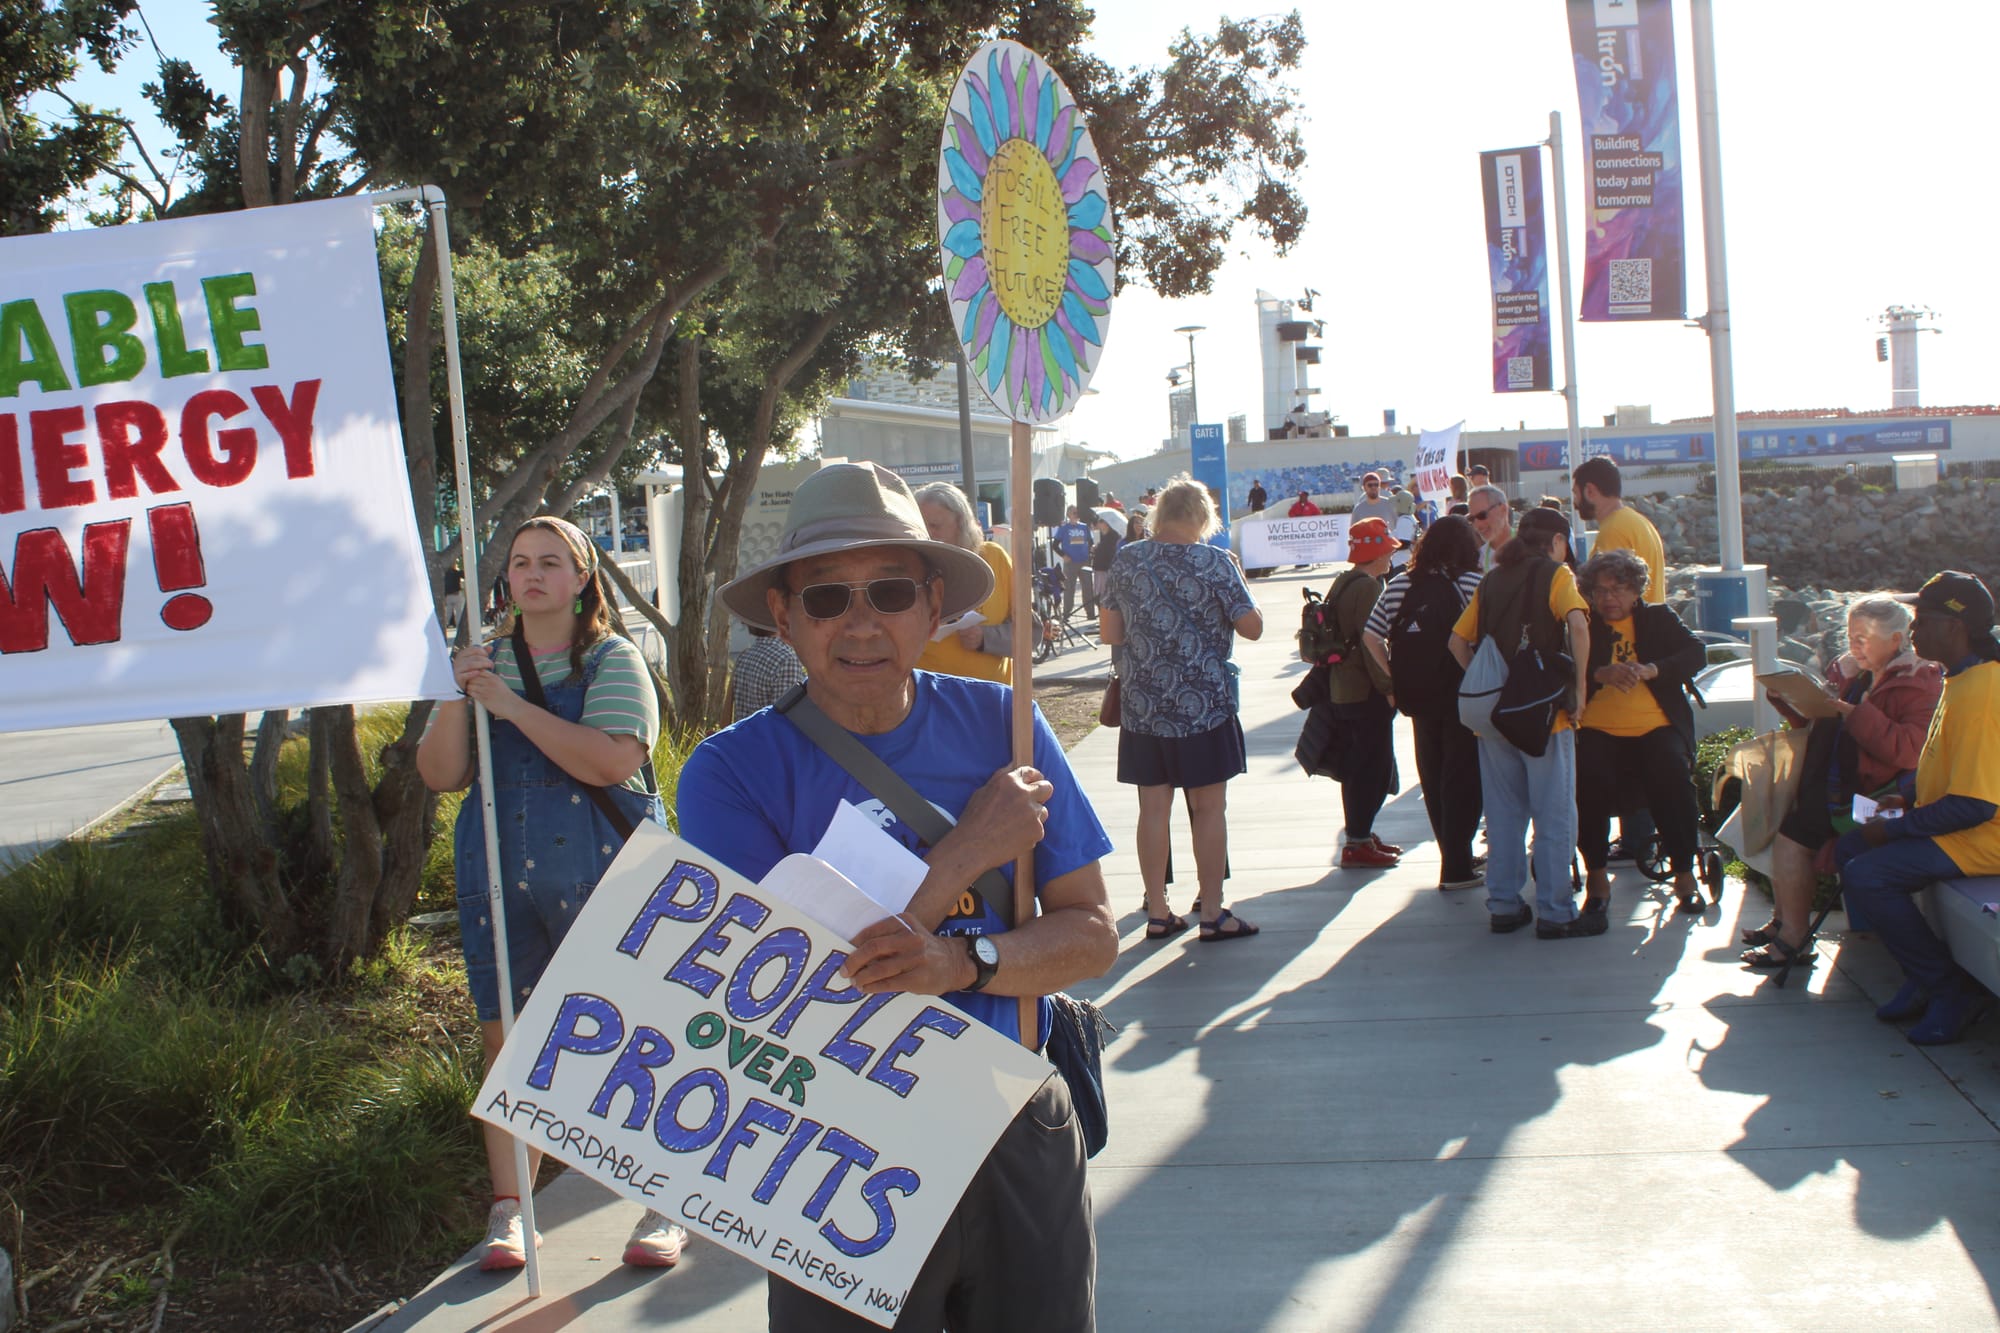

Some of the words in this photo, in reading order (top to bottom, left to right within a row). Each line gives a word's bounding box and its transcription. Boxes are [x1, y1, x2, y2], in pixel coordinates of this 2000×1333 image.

[1594, 136, 1640, 151] Building
[1595, 154, 1661, 168] connections
[993, 151, 1049, 214] FOSSIL
[1596, 175, 1628, 189] today
[1631, 173, 1651, 186] and
[1597, 194, 1651, 206] tomorrow
[1000, 203, 1047, 256] FREE
[994, 248, 1056, 304] FUTURE
[1497, 292, 1538, 303] Experience
[1497, 306, 1523, 314] energy
[1525, 304, 1538, 312] the
[1498, 316, 1538, 324] movement
[0, 271, 270, 397] ABLE
[1195, 427, 1215, 439] GATE
[899, 465, 929, 474] KITCHEN
[930, 464, 960, 473] MARKET
[1267, 519, 1339, 534] WELCOME
[1268, 532, 1316, 541] PROMENADE
[617, 859, 971, 1099] PEOPLE
[686, 1011, 816, 1107] OVER
[527, 992, 921, 1259] PROFITS
[486, 1089, 670, 1198] AFFORDABLE
[681, 1192, 767, 1250] CLEAN
[771, 1237, 864, 1299] ENERGY
[864, 1285, 906, 1316] NOW!
